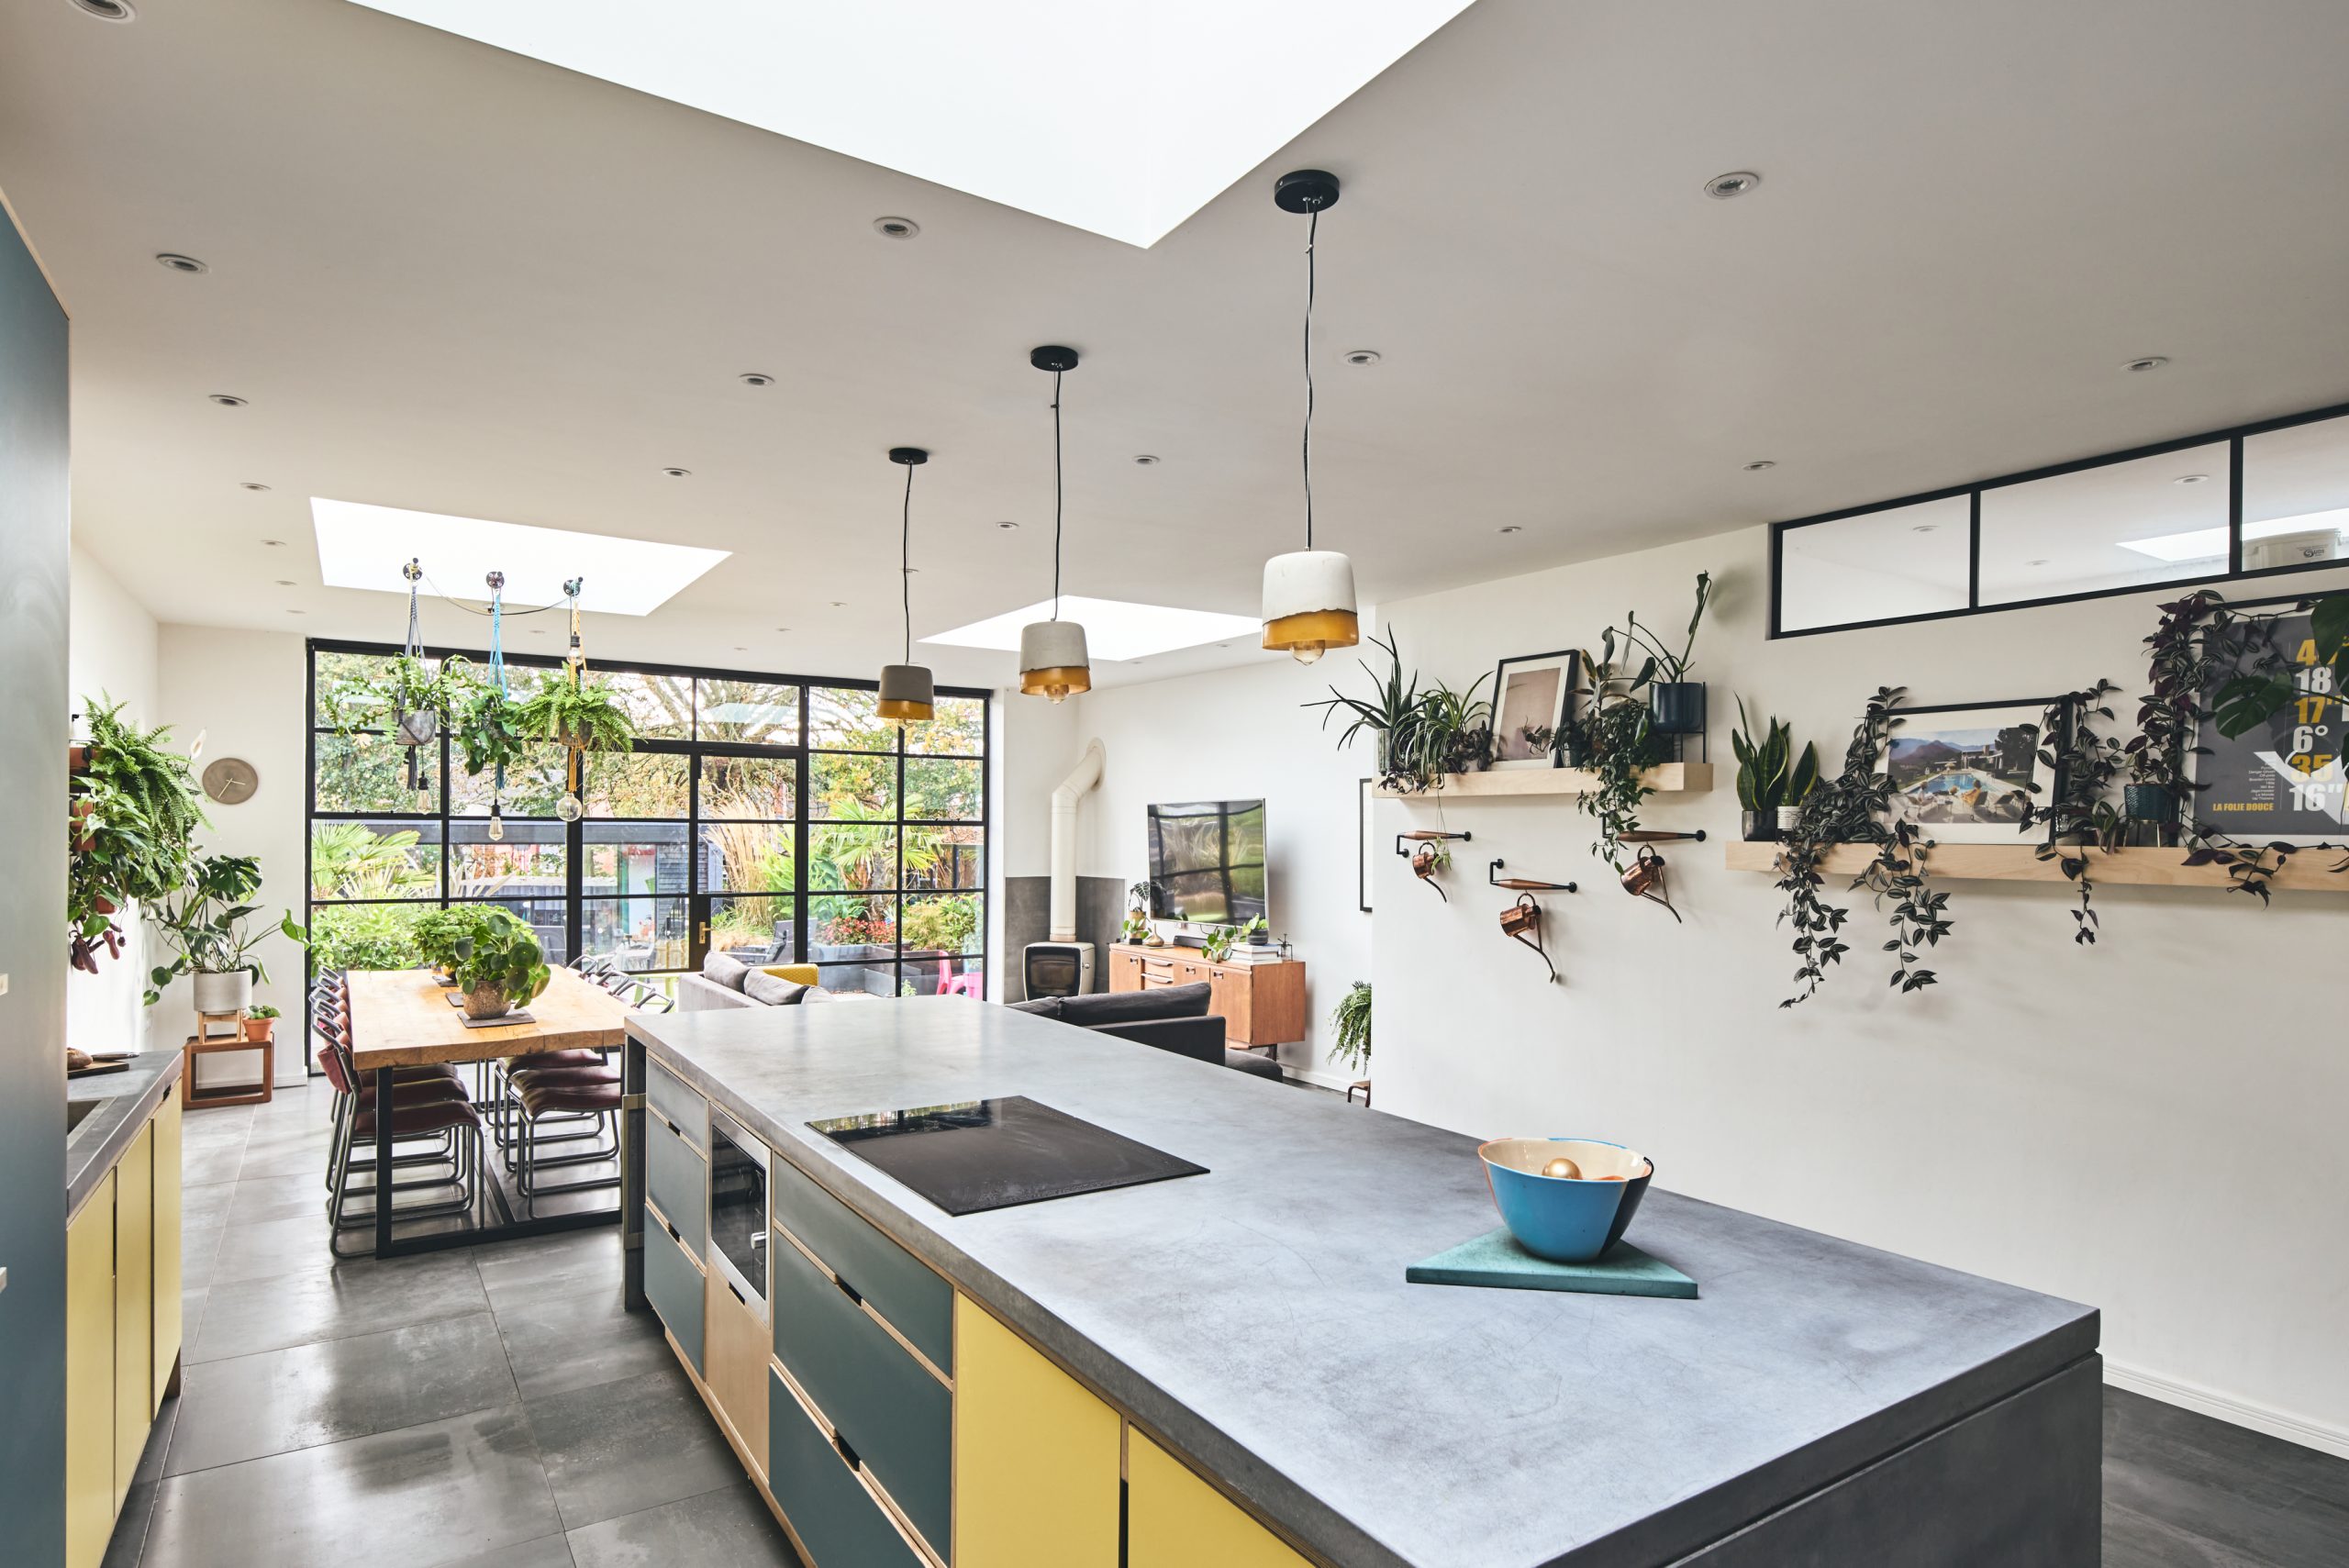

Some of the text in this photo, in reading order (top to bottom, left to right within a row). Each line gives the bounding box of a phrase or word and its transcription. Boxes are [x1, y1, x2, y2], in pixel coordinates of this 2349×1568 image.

[2295, 666, 2332, 695] 18
[2293, 726, 2329, 753] 6°
[2290, 754, 2332, 783] 35
[2213, 803, 2274, 811] LA FOLIE DOUCE
